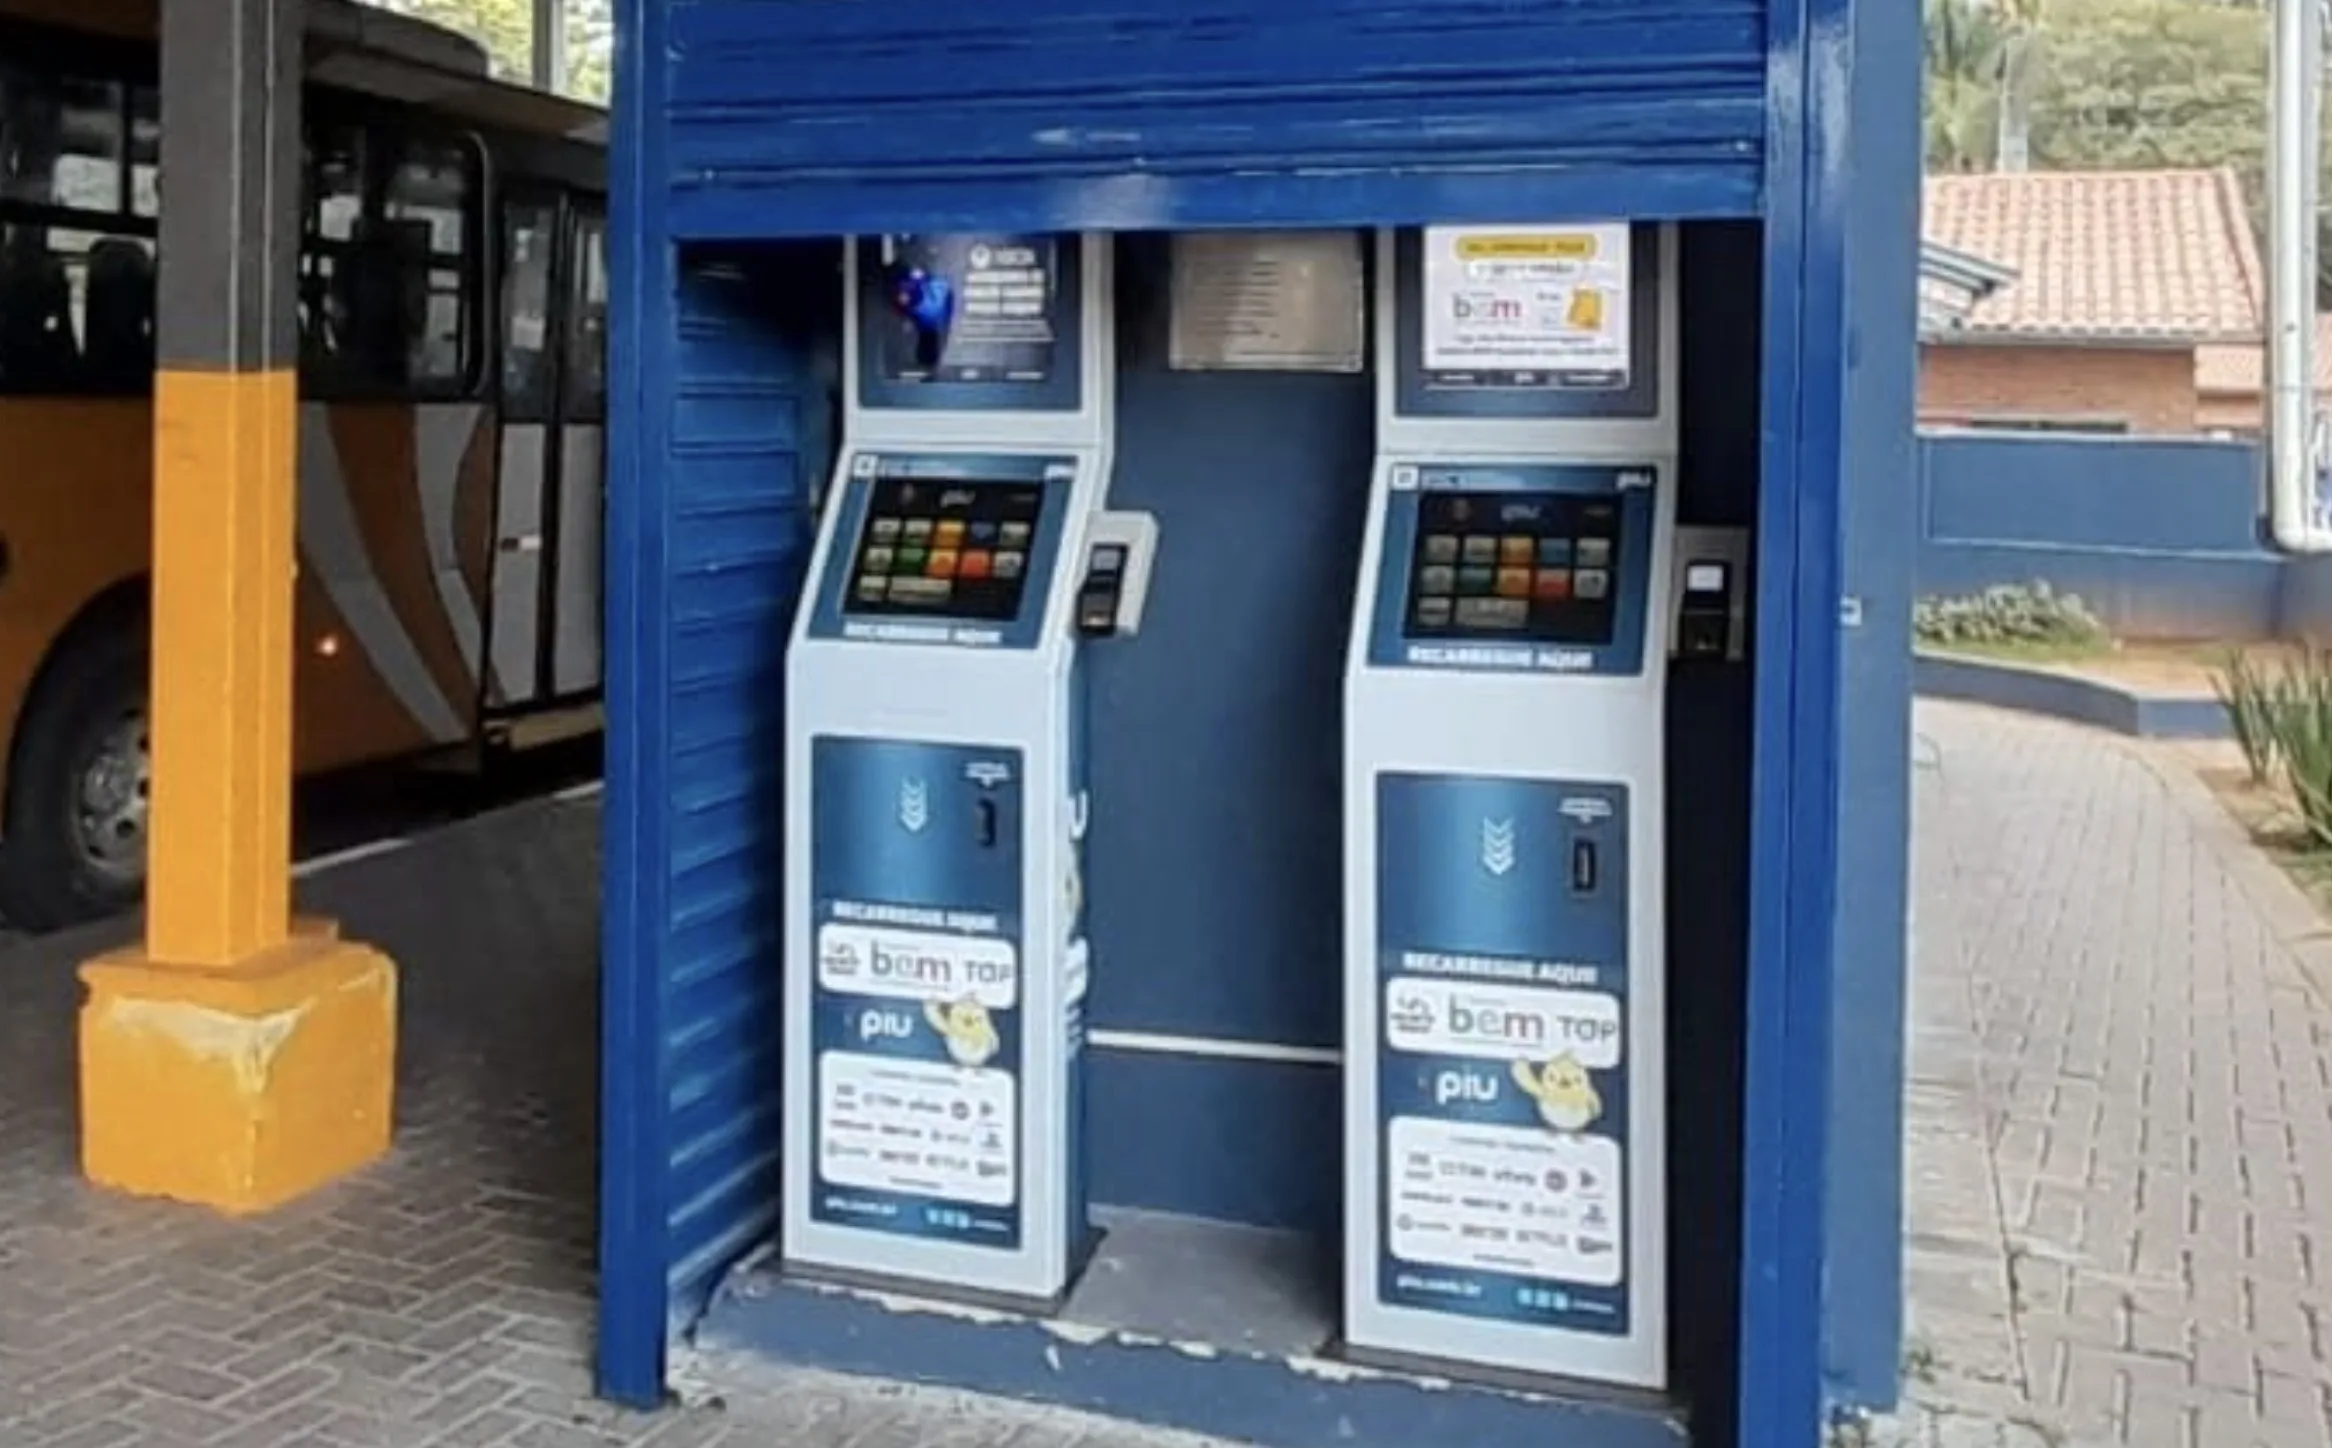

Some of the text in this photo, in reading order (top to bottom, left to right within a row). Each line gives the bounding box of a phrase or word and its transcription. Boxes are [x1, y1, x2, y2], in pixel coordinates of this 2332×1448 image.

[870, 940, 951, 983] bem
[1403, 952, 1598, 986] RECARREGUE AQUI
[860, 1009, 914, 1042] piu
[1449, 993, 1545, 1039] bem
[1557, 1014, 1618, 1042] TOP
[1436, 1068, 1499, 1106] piu
